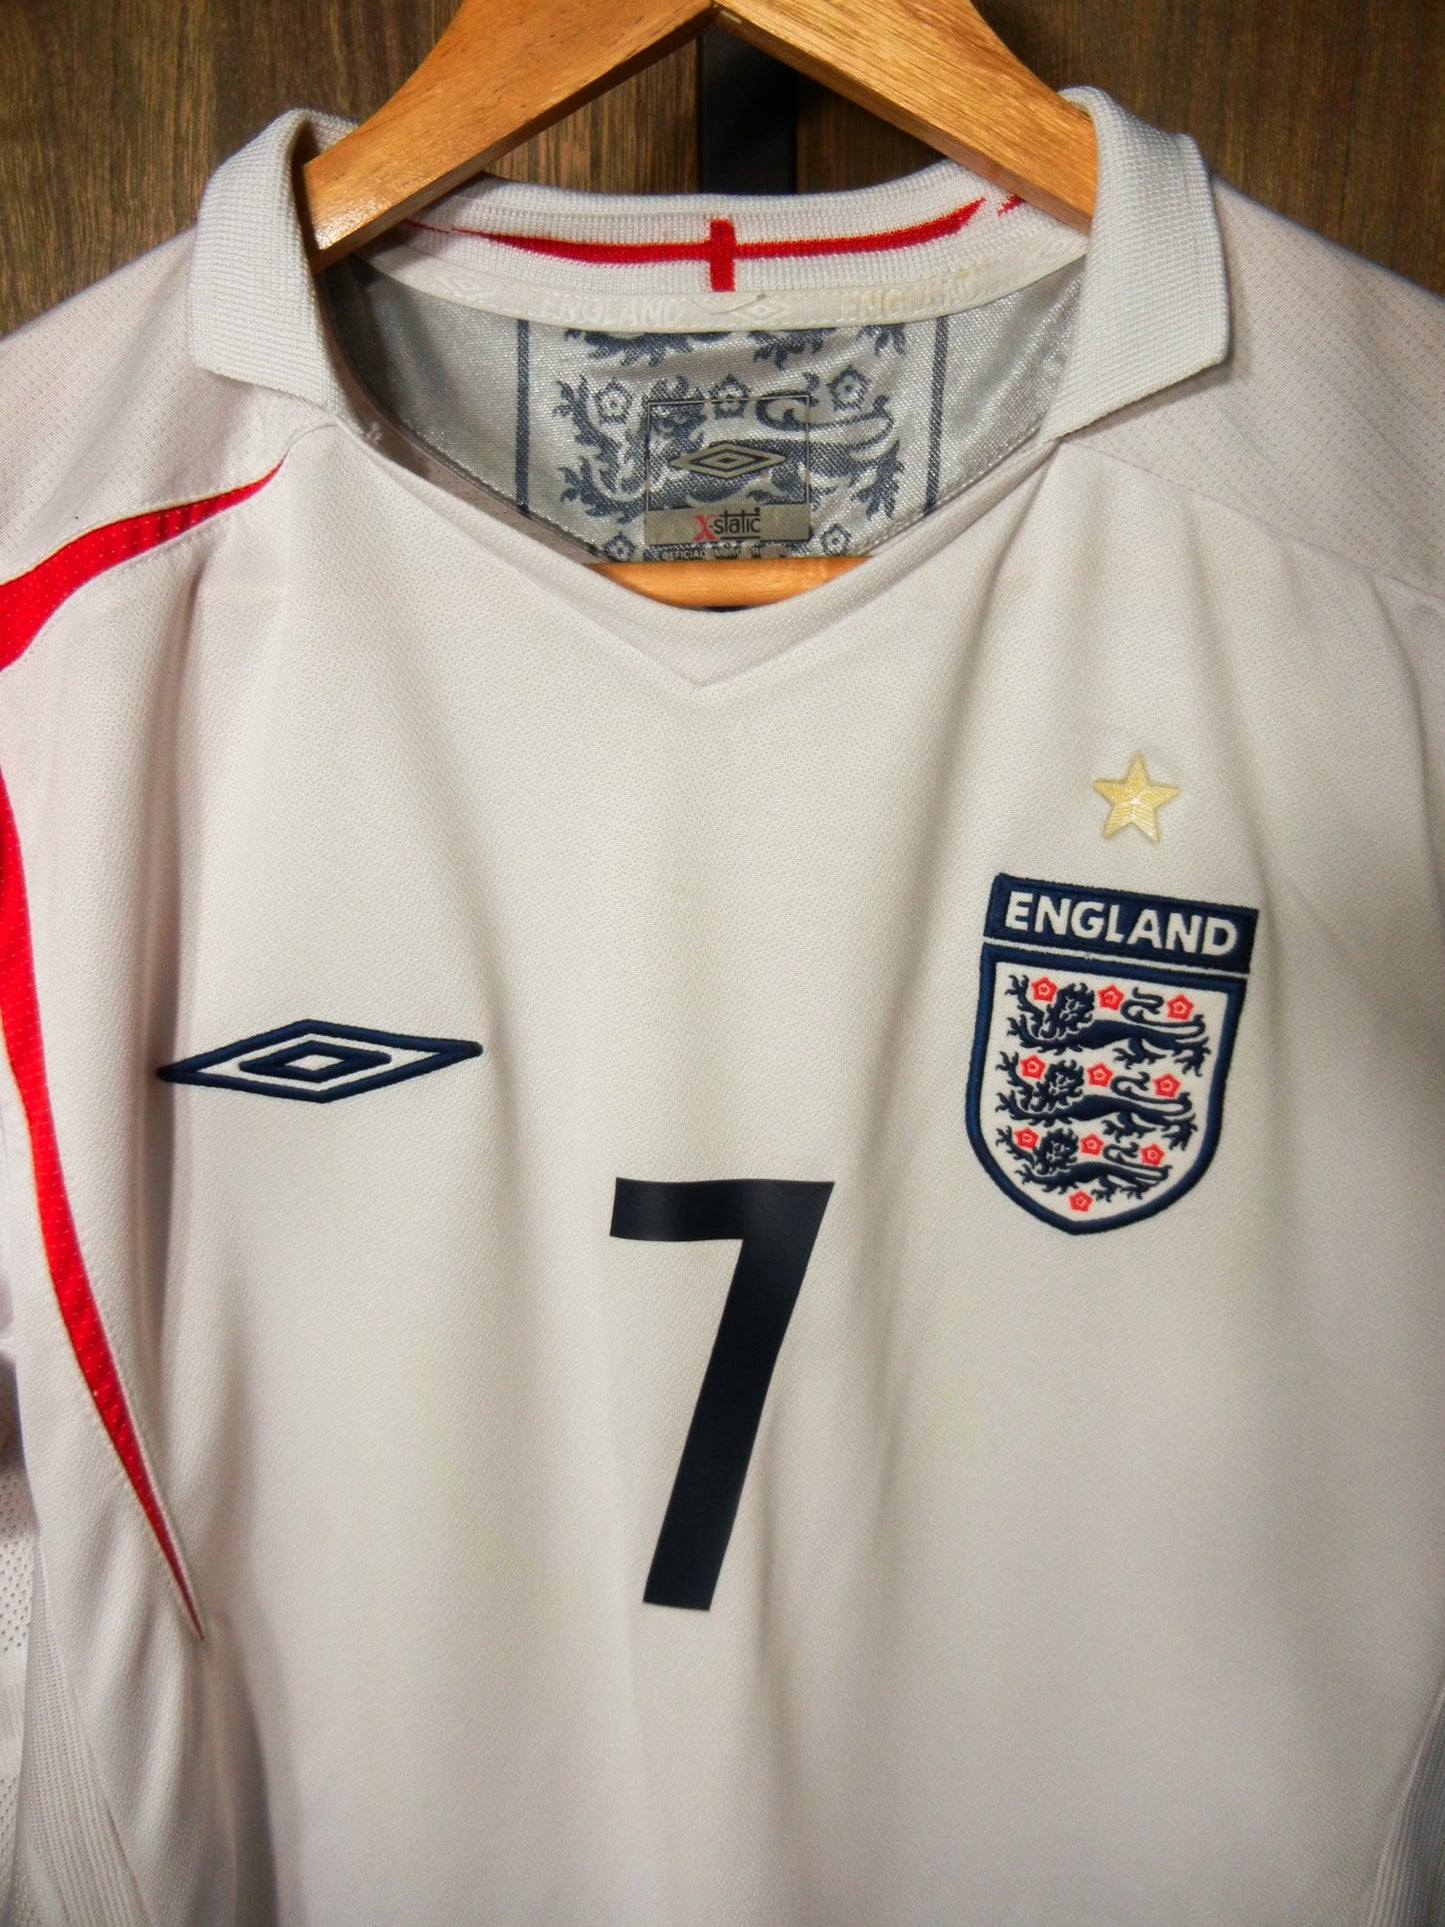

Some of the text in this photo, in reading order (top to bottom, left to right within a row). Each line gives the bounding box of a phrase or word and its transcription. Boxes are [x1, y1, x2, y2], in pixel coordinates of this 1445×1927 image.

[693, 508, 761, 541] X-static
[1005, 890, 1237, 956] ENGLAND
[610, 1177, 834, 1611] 7
